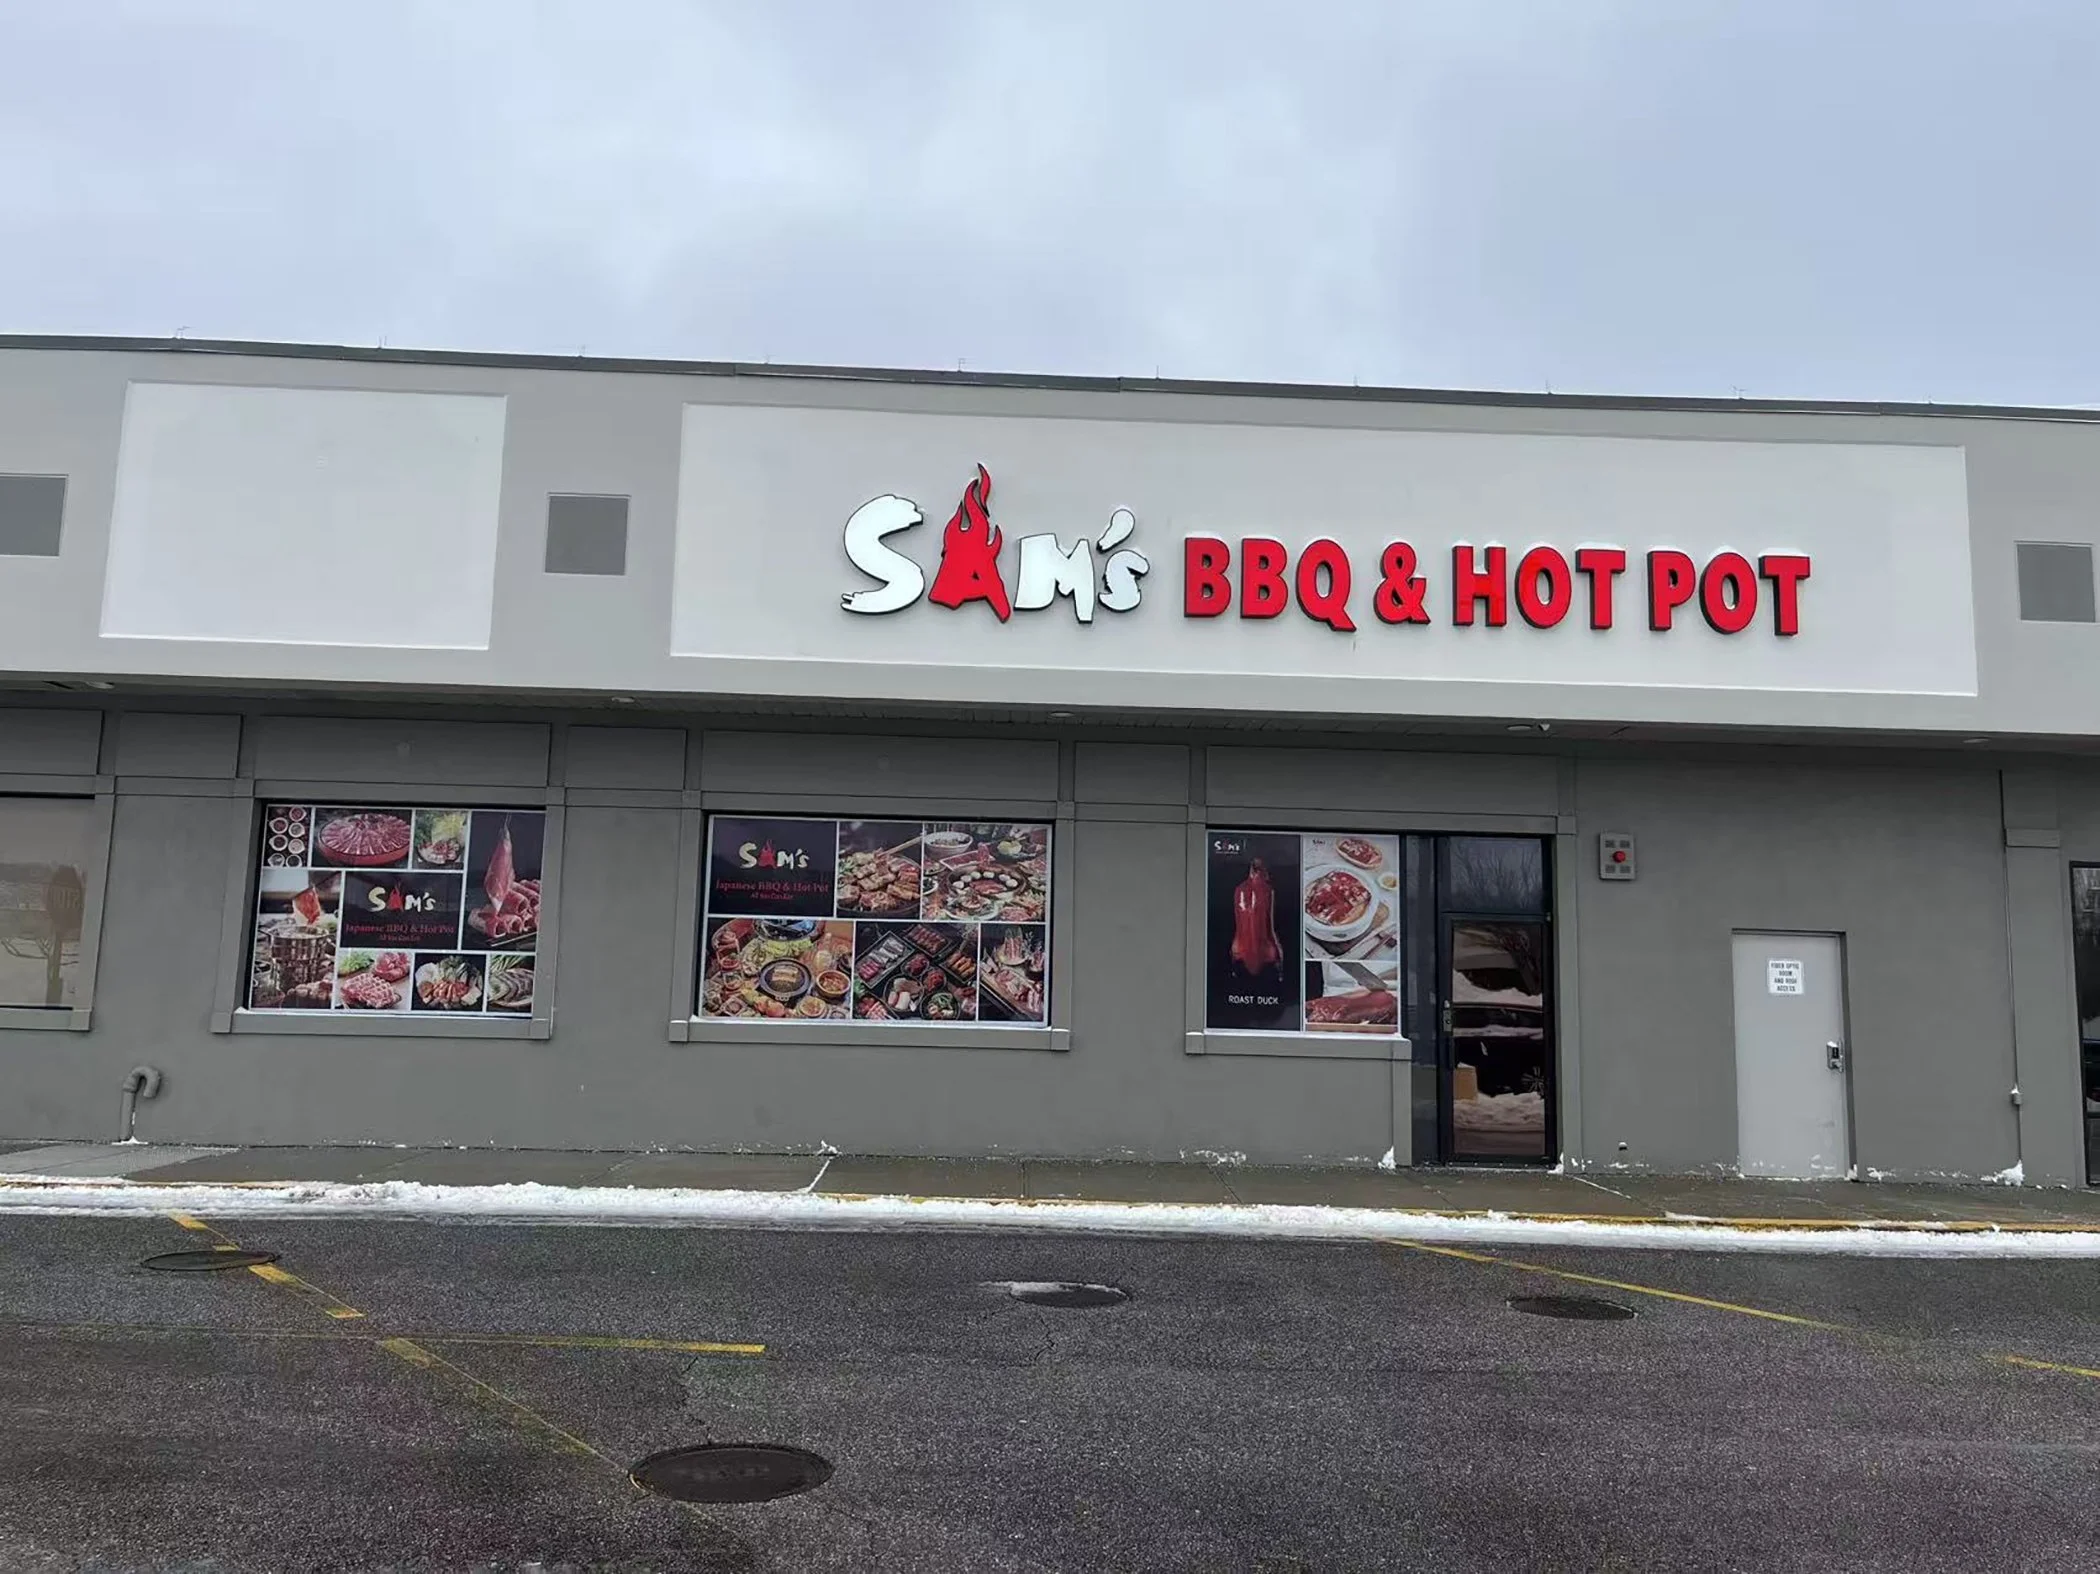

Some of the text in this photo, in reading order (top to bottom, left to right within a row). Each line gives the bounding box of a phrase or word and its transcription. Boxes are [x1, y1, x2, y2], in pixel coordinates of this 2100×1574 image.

[1184, 538, 1357, 633] BBQ
[1373, 541, 1431, 625] &
[1452, 543, 1626, 629] HOT
[1647, 550, 1811, 637] POT
[716, 880, 829, 893] Japanese BBQ & Hot Pot
[385, 923, 408, 934] BBQ
[420, 924, 437, 934] Hot
[1228, 994, 1279, 1005] ROAST DUCK
